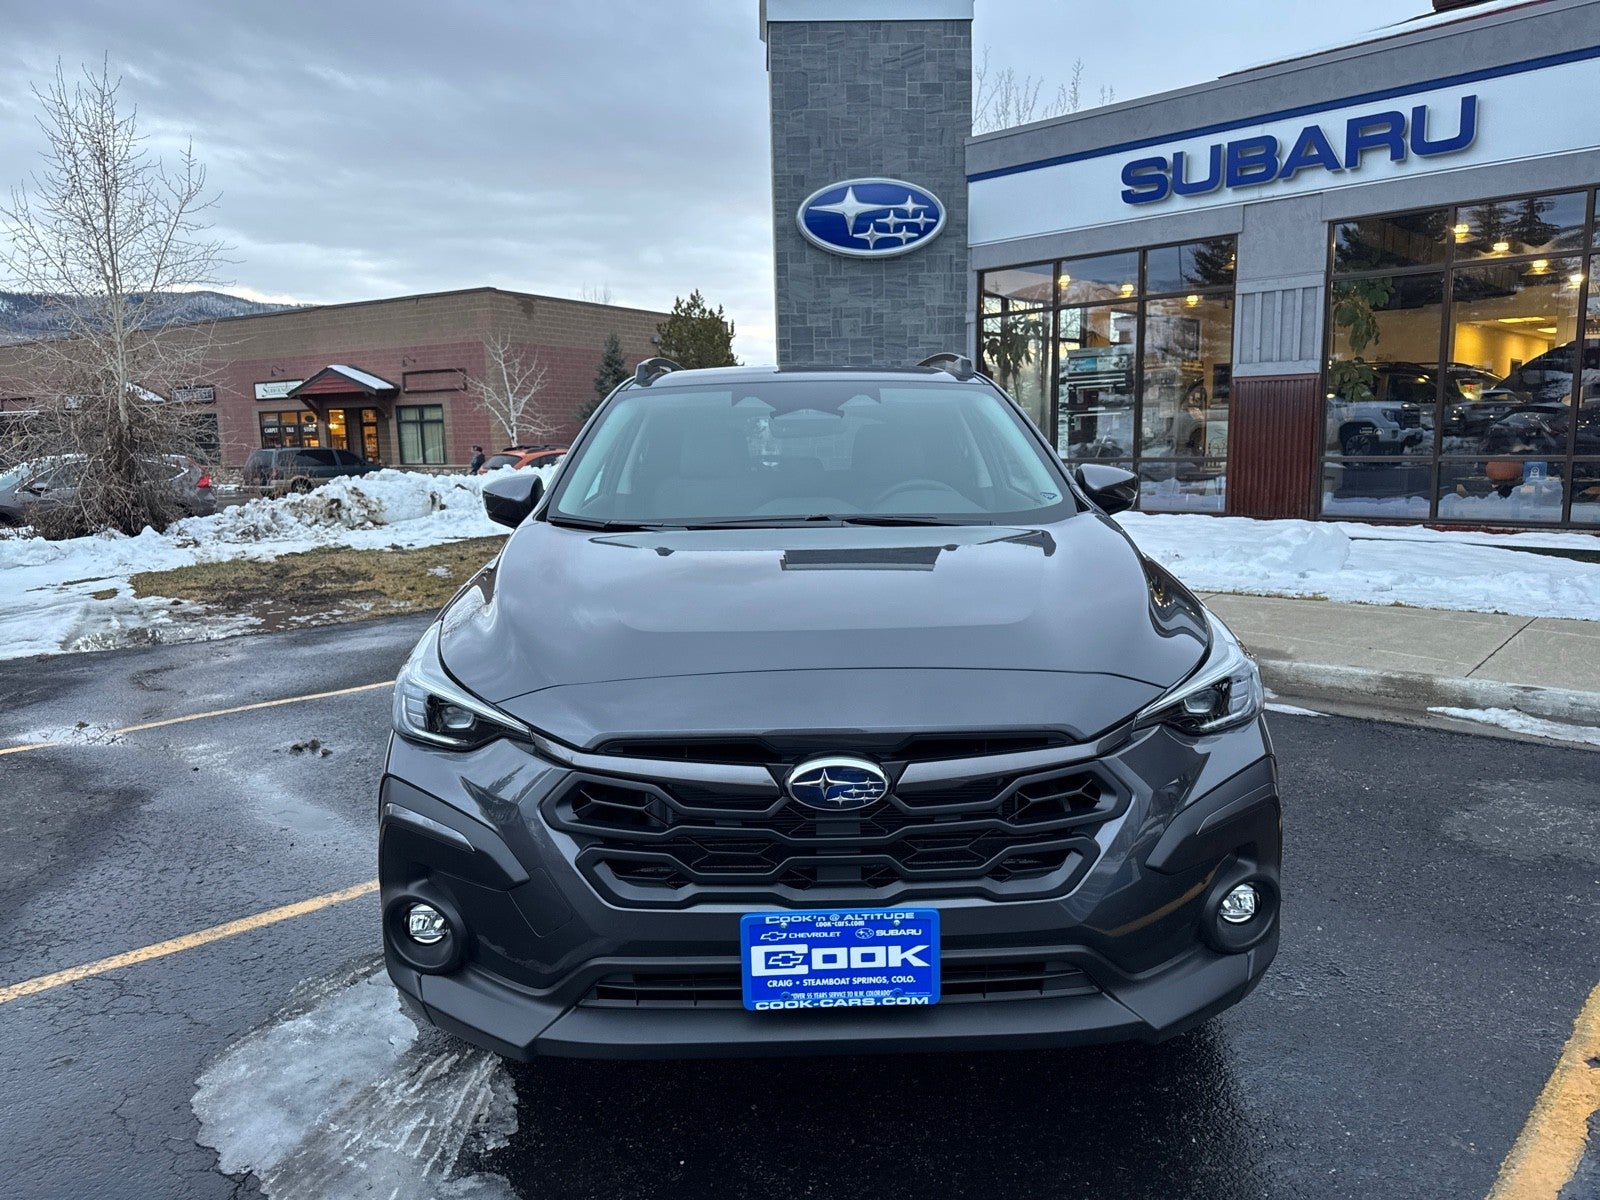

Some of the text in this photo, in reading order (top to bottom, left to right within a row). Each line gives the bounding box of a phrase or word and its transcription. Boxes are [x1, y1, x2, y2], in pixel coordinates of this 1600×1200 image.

[1121, 95, 1478, 205] SUBARU
[844, 912, 915, 921] ALTITUDE
[789, 931, 841, 939] CHEVROLET
[876, 929, 922, 937] SUBARU
[751, 944, 931, 977] COOK
[767, 975, 916, 988] CRAIG STEAMBOAT SPRINGS, COLO.
[755, 996, 929, 1011] COOK-CARS.COM
